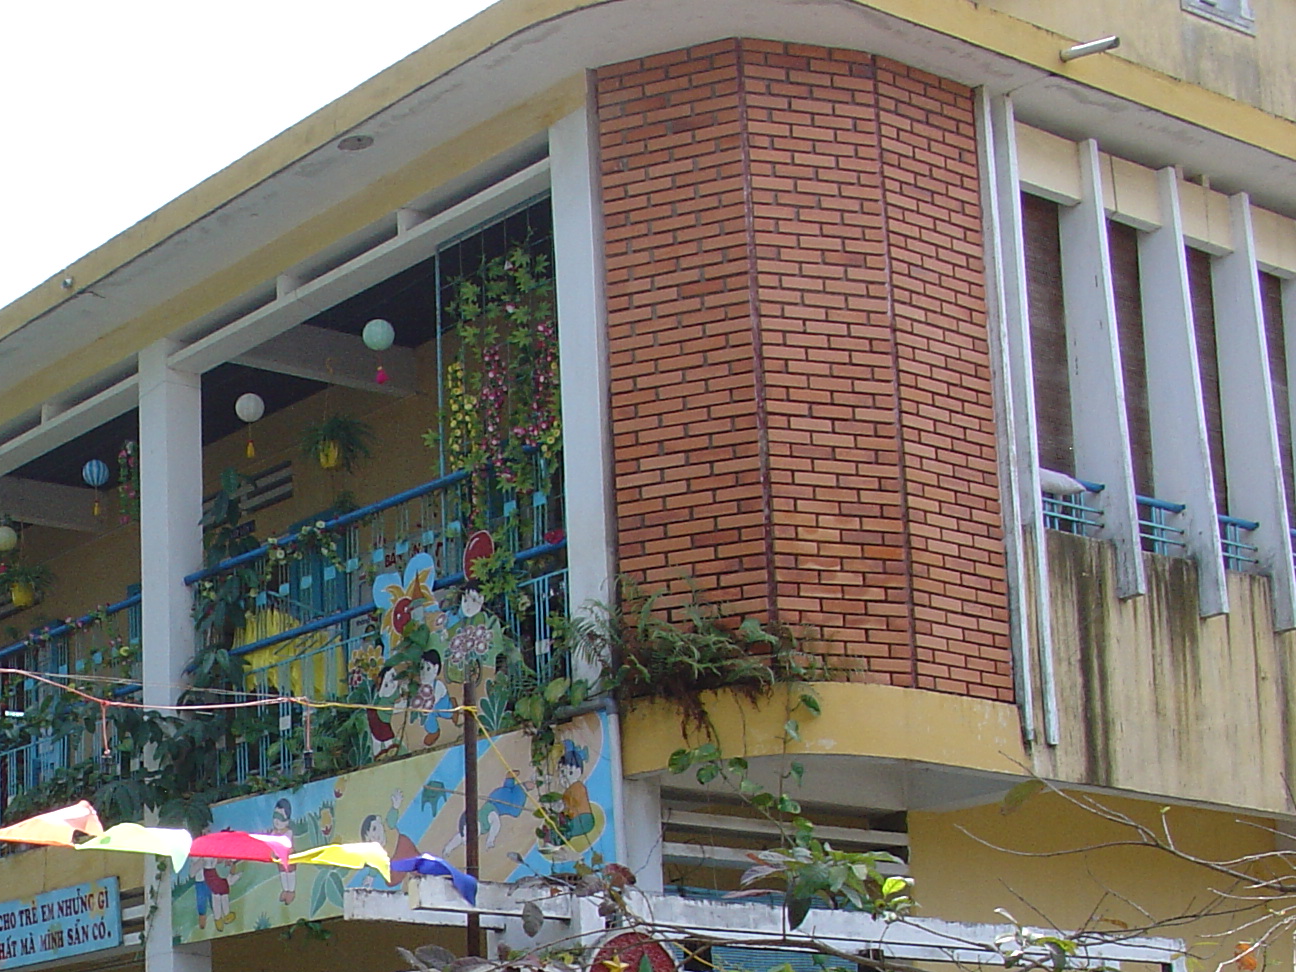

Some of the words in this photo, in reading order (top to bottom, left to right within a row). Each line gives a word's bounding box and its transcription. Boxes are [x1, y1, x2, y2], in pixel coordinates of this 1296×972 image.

[19, 900, 38, 927] TRẺ
[41, 901, 55, 922] EM
[97, 886, 109, 909] GÌ
[20, 932, 35, 956] MÀ
[40, 929, 64, 952] MÌNH
